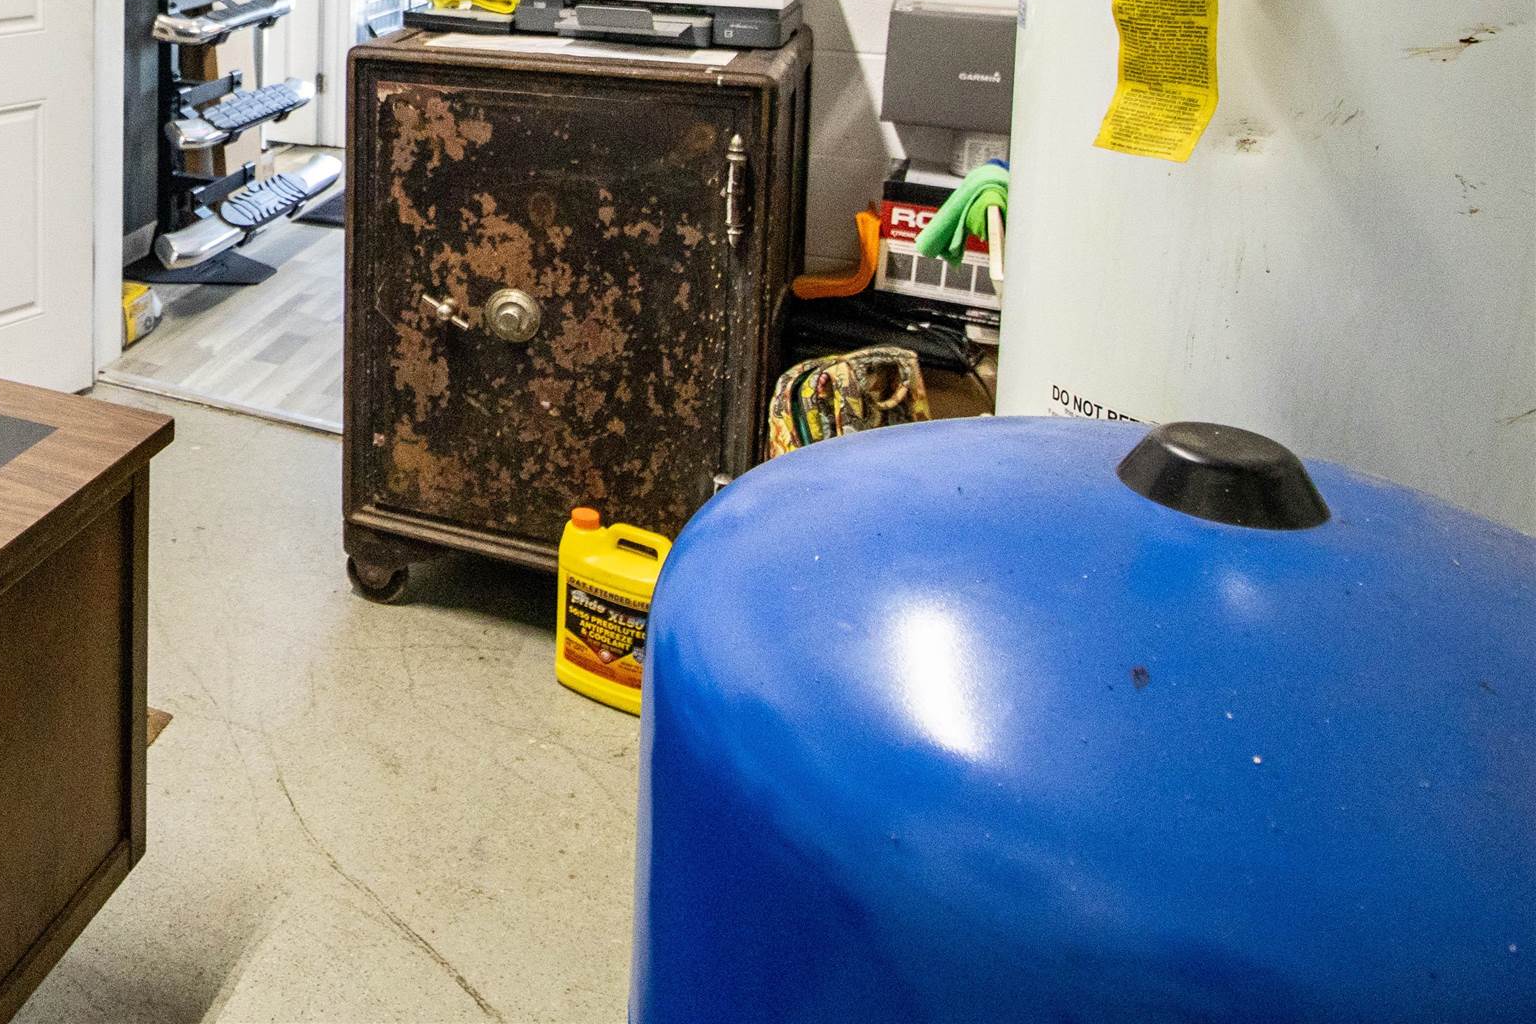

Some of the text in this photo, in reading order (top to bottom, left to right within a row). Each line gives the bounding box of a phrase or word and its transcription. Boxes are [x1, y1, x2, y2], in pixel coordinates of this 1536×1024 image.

[958, 72, 1001, 83] GARMIN
[1052, 384, 1070, 406] DO
[1073, 395, 1103, 419] NOT
[579, 620, 633, 645] ANTIFREEZE
[589, 631, 631, 651] COOLANT
